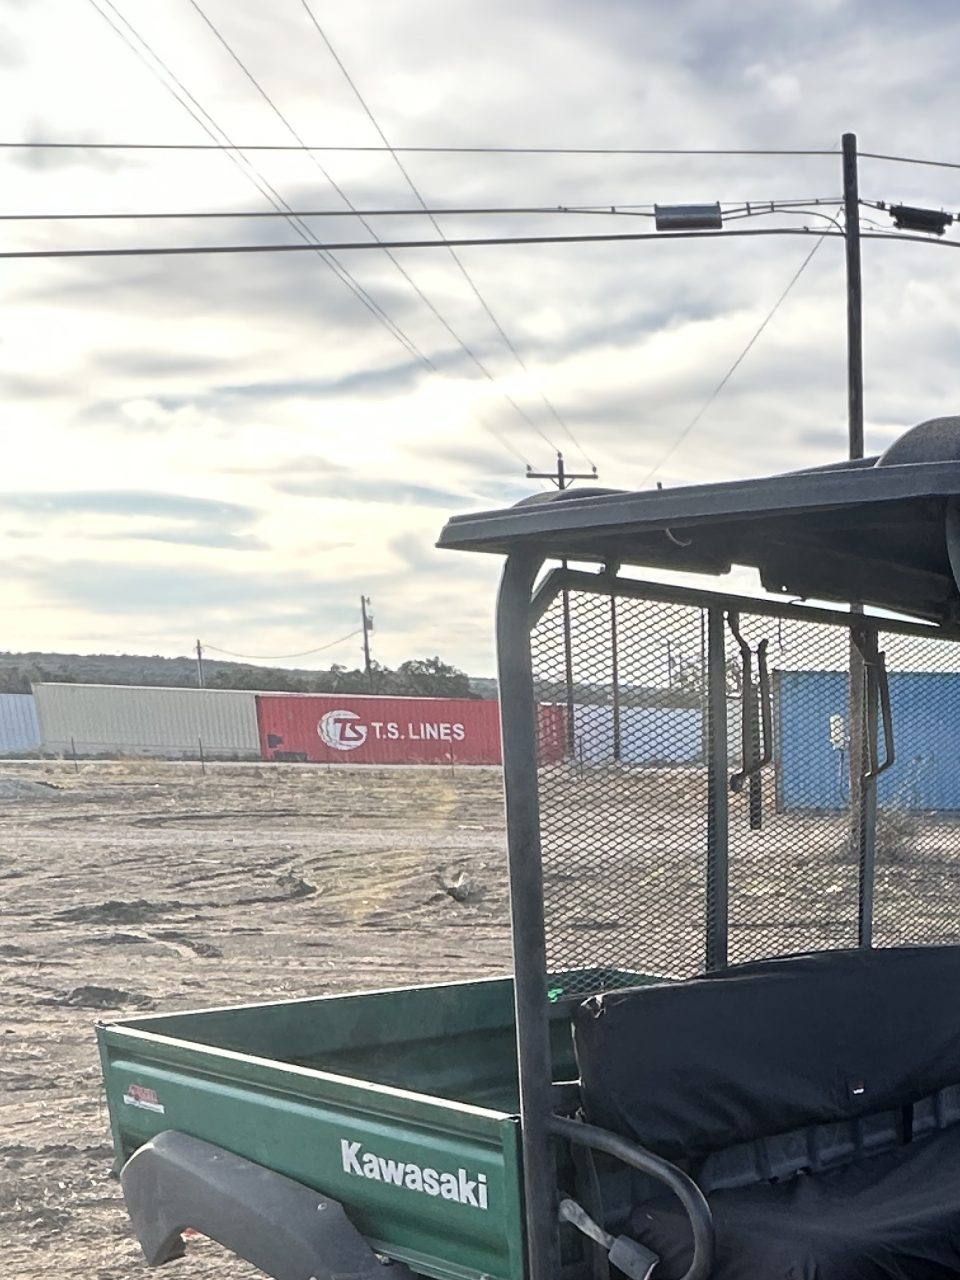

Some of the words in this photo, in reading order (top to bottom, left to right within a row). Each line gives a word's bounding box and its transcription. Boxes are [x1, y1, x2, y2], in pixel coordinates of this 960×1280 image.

[371, 721, 405, 740] T.S.
[408, 722, 465, 742] LINES
[340, 1138, 488, 1211] Kawasaki
